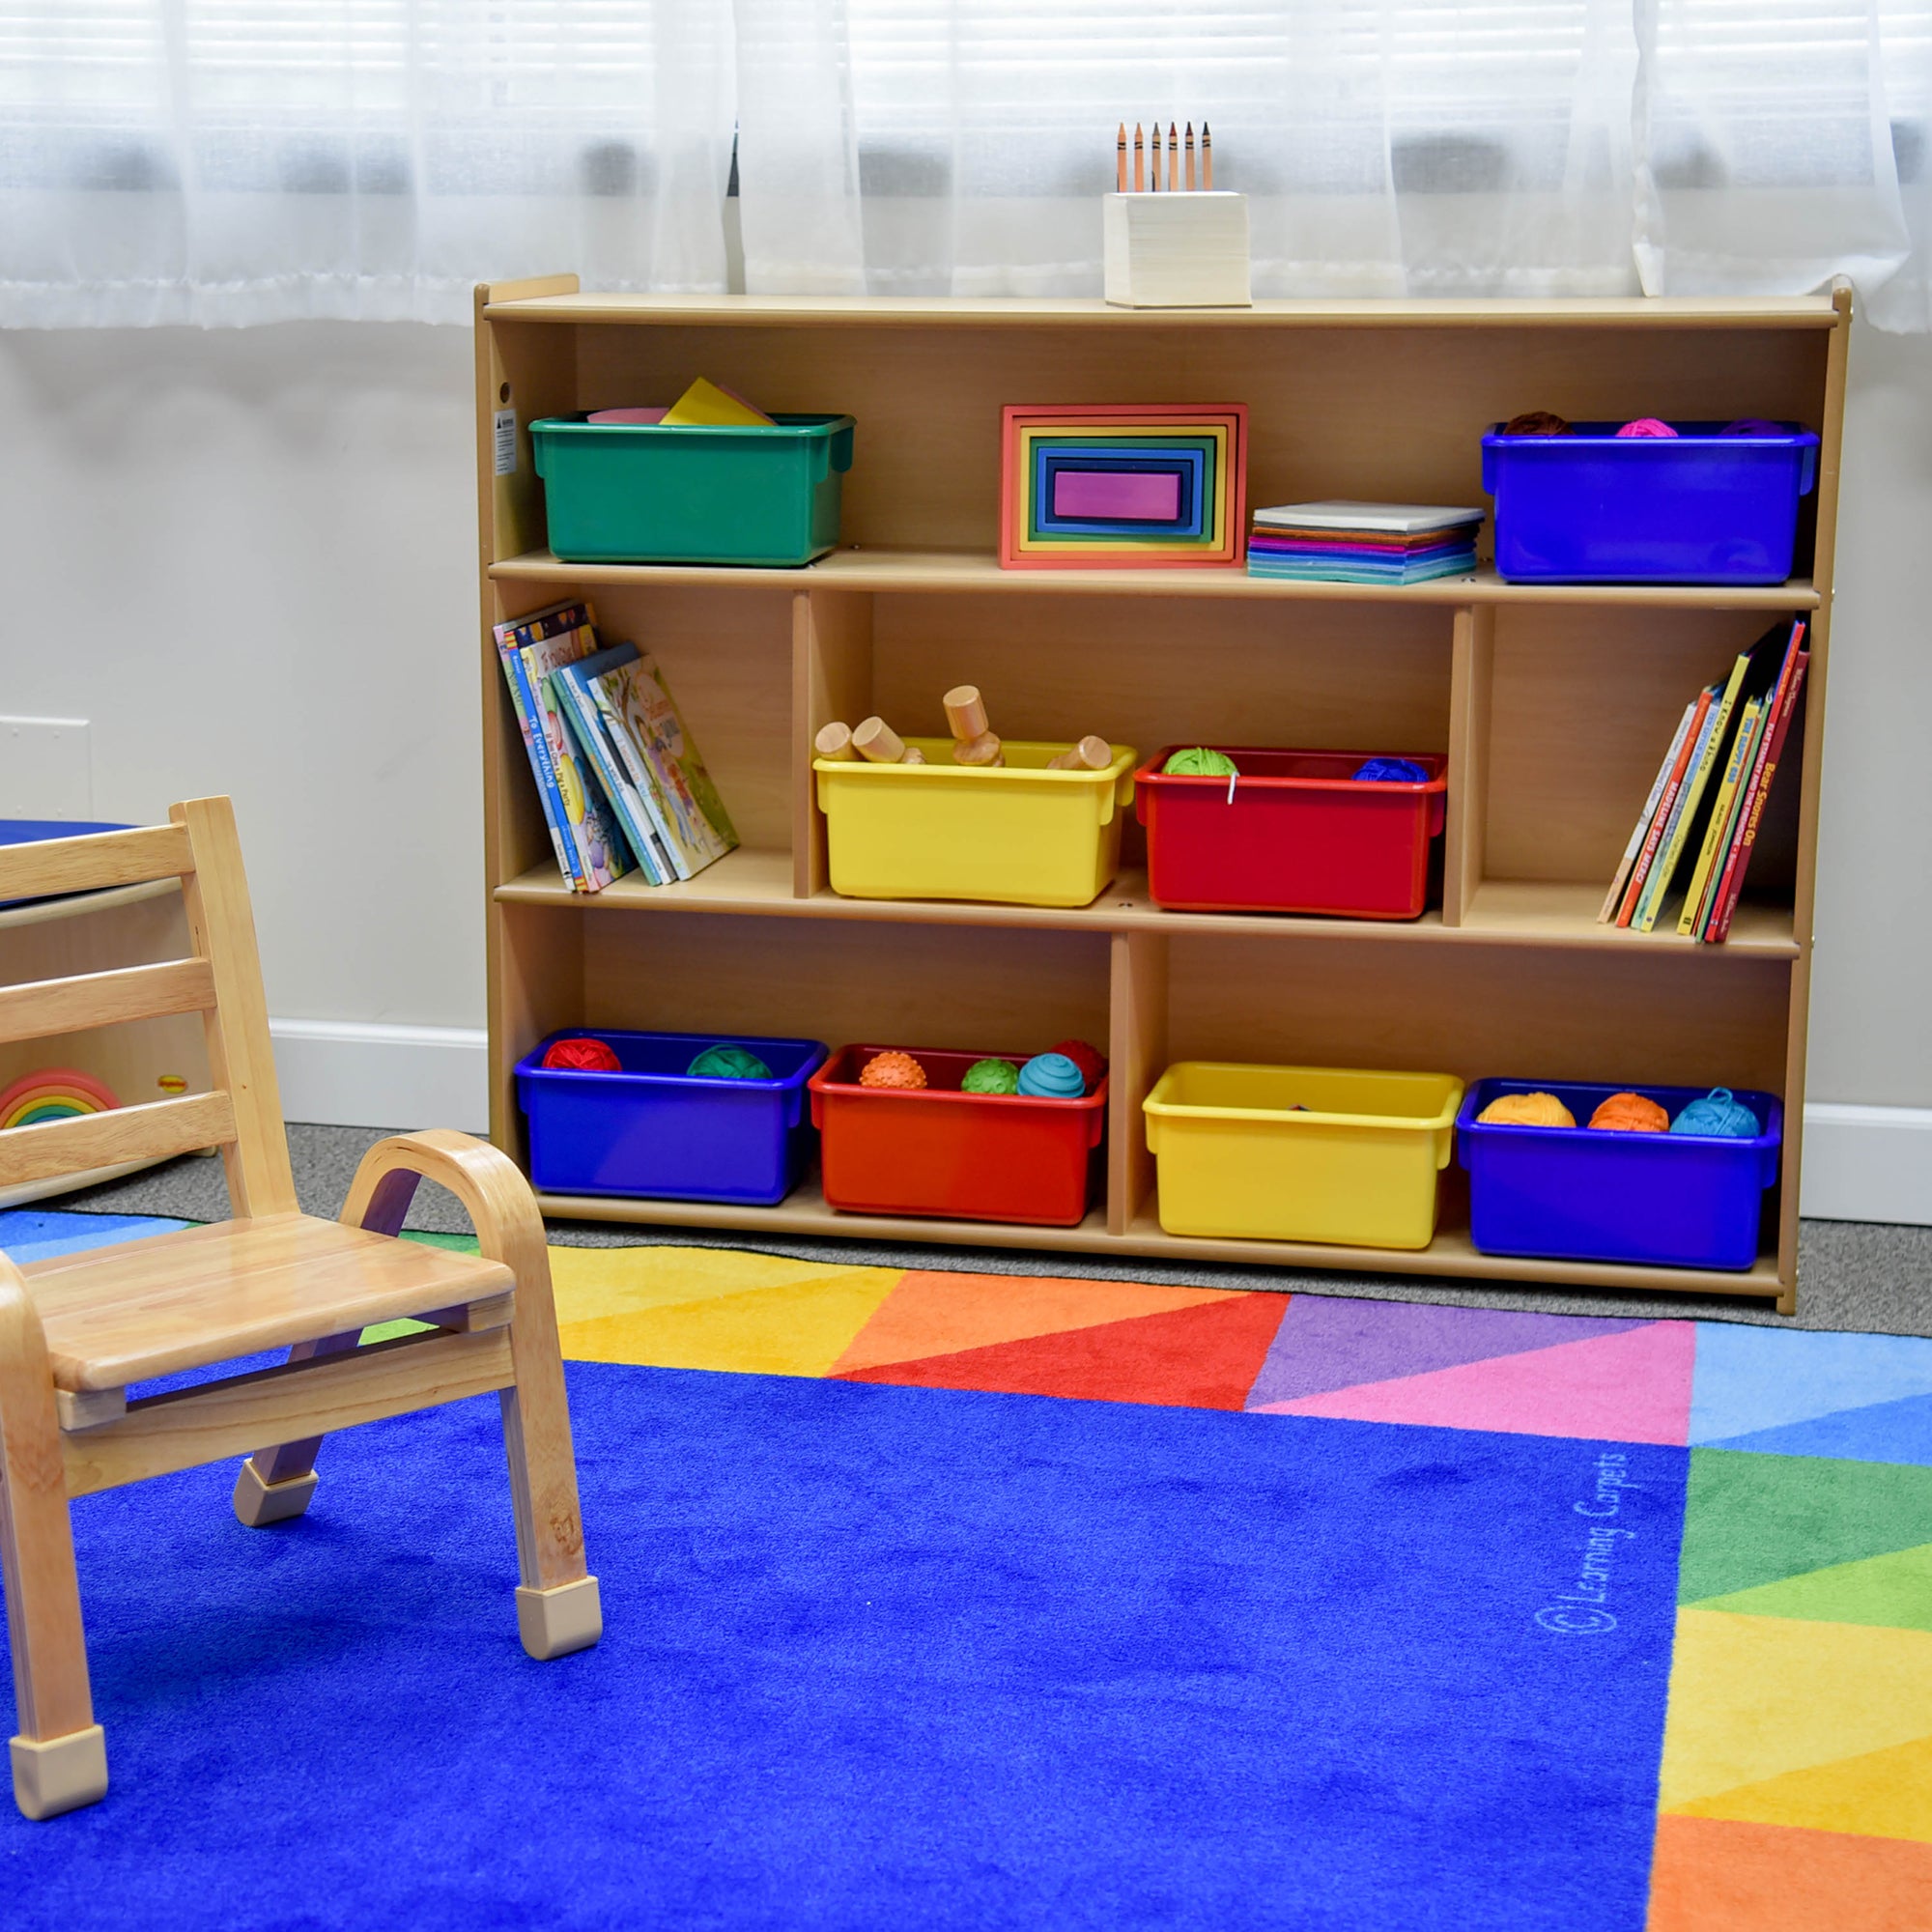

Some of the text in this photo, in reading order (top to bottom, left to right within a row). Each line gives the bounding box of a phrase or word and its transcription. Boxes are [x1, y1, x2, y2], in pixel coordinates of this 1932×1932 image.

[527, 714, 538, 729] To
[1714, 707, 1728, 735] Know
[1742, 717, 1754, 733] THE
[1764, 723, 1776, 742] FLAT
[545, 731, 553, 740] If
[547, 739, 556, 752] You
[532, 731, 554, 789] Everything
[550, 751, 560, 766] Give
[1699, 744, 1716, 772] Rhino
[1734, 735, 1747, 764] HAPPY
[1756, 741, 1770, 774] STANLEY
[554, 771, 566, 784] Pig
[1749, 773, 1760, 791] AND
[560, 787, 571, 807] Party
[1655, 781, 1679, 828] MADELINE
[1742, 761, 1776, 847] Bear Snores On
[1746, 790, 1755, 807] THE
[1733, 807, 1750, 846] FIREHOUSE
[1646, 828, 1662, 853] SAYS
[1634, 853, 1652, 885] MERCI
[1573, 1452, 1642, 1517] Carpets
[1556, 1526, 1636, 1604] Learning
